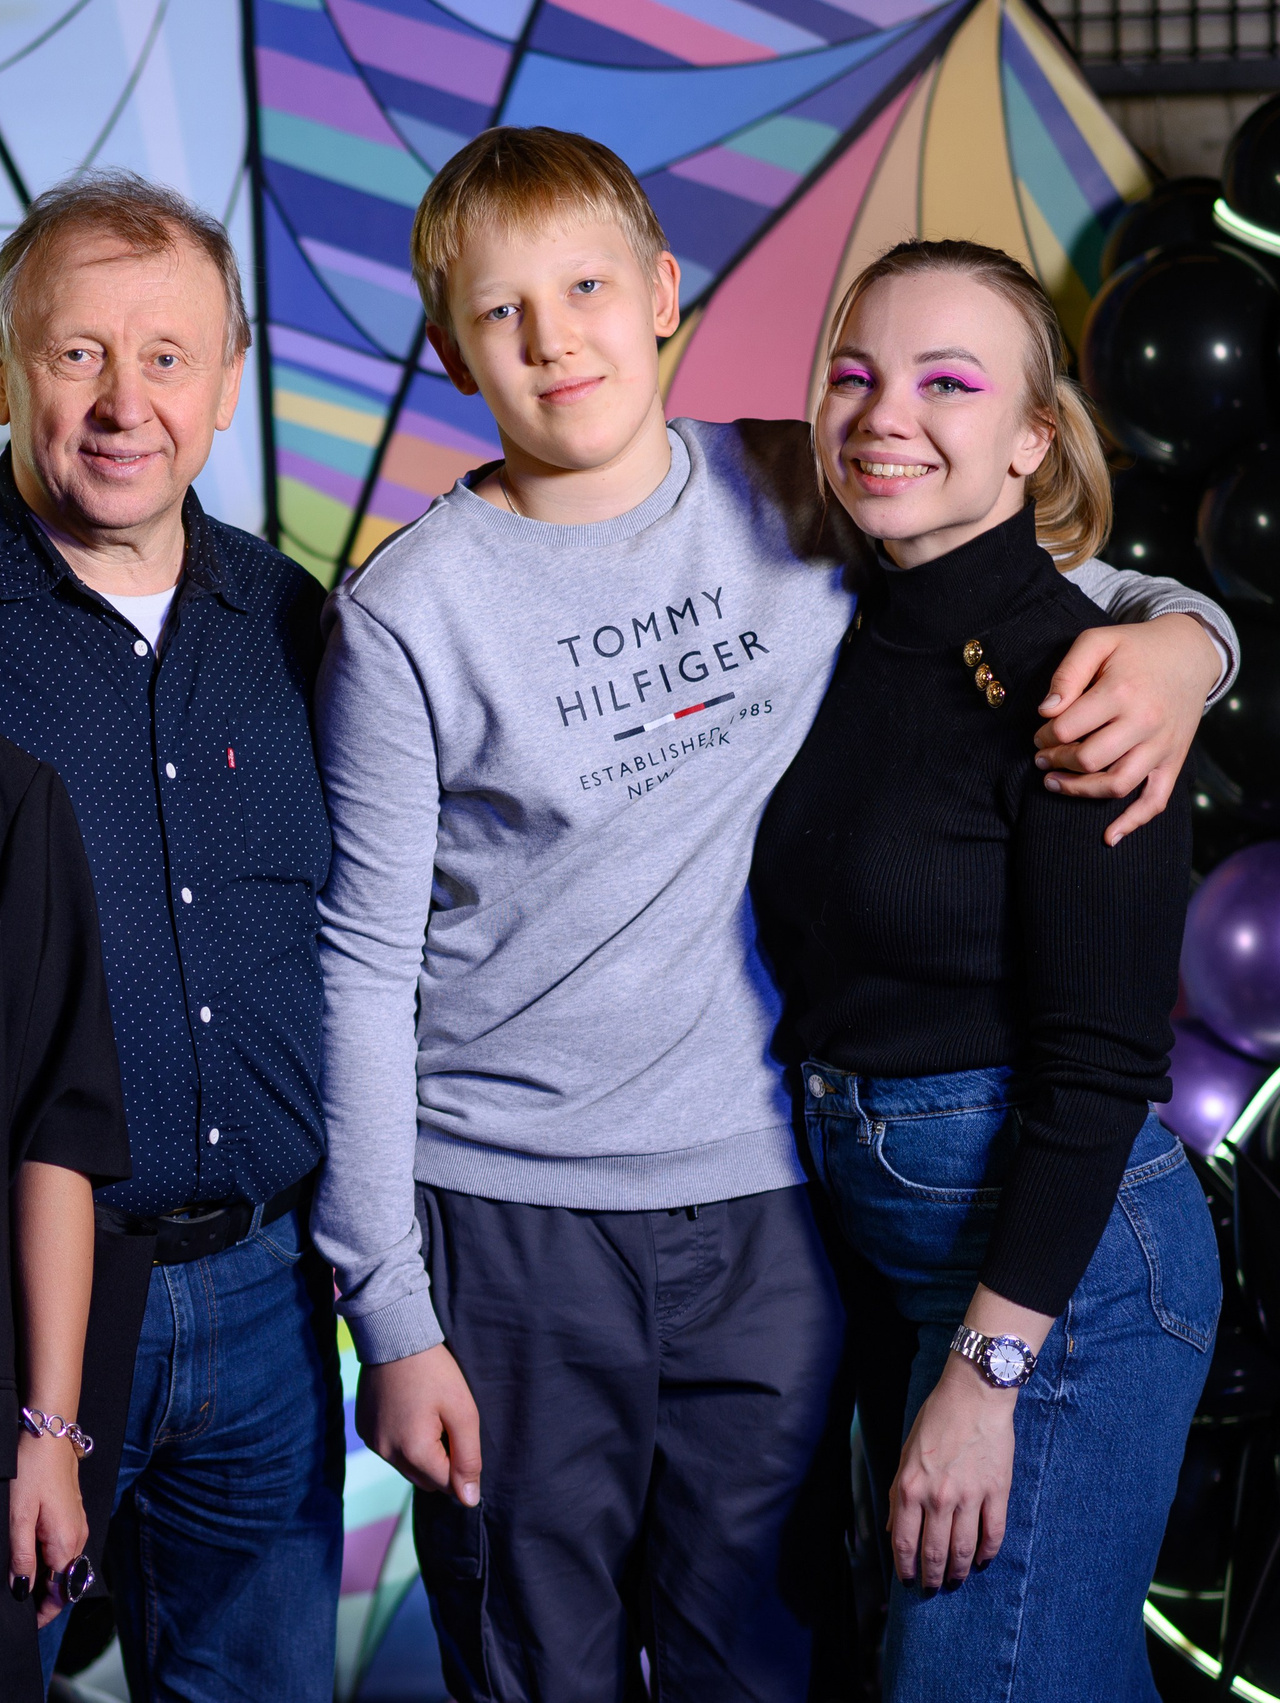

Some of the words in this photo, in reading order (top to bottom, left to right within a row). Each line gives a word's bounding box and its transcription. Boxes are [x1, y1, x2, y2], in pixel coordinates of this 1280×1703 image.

[557, 586, 723, 668] TOMMY
[555, 630, 770, 727] HILFIGER
[627, 768, 675, 800] NEW
